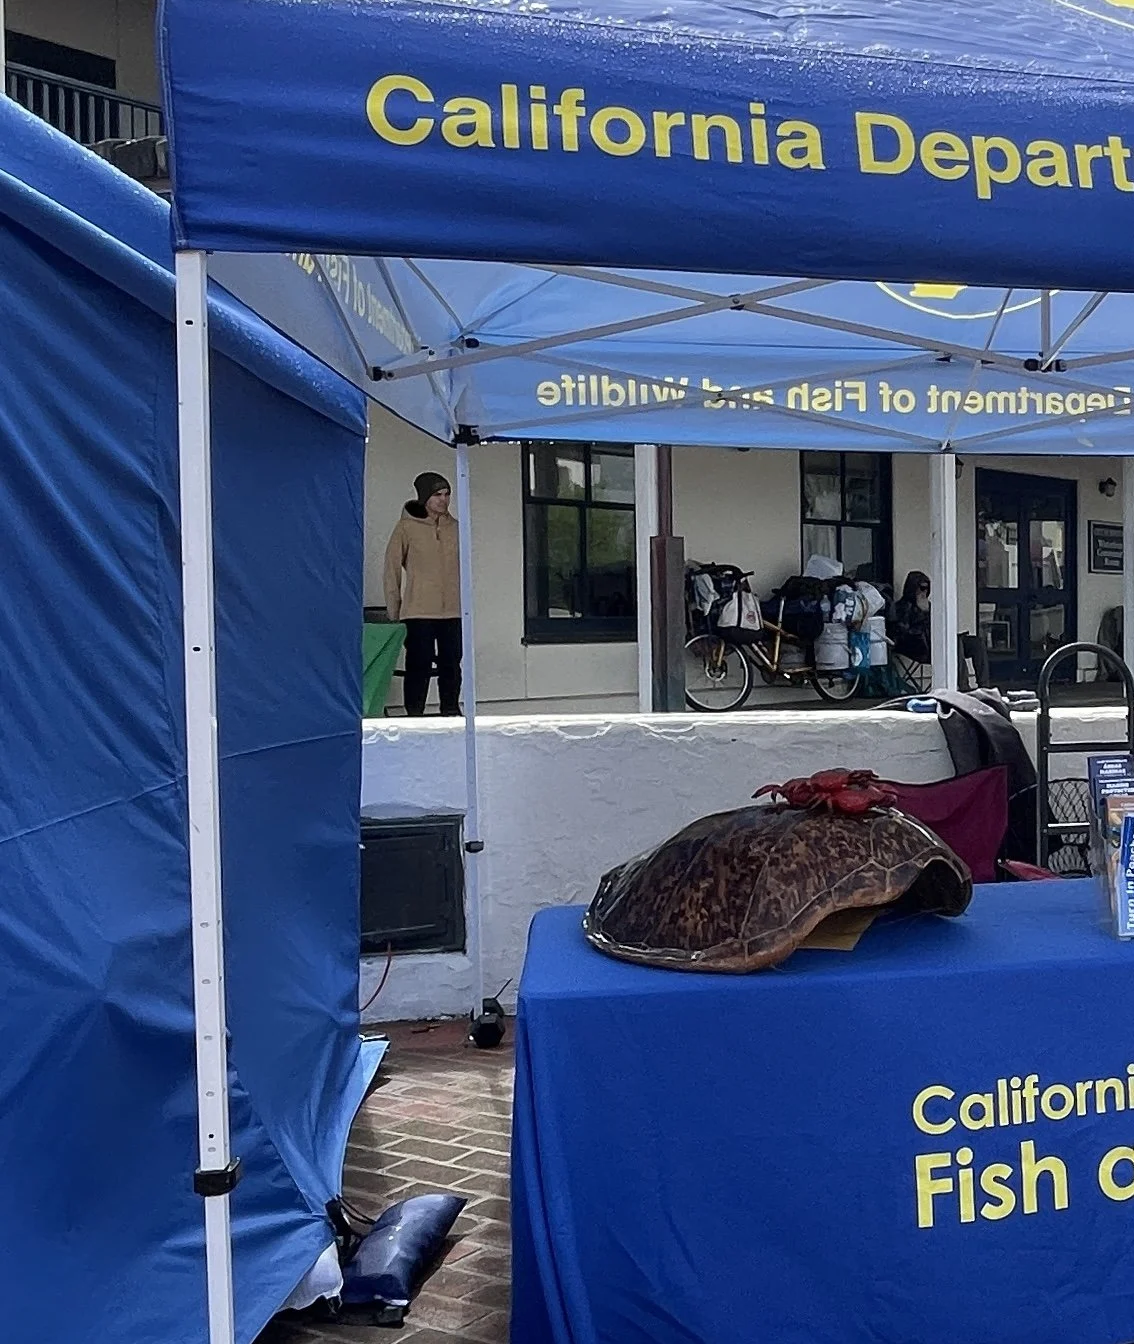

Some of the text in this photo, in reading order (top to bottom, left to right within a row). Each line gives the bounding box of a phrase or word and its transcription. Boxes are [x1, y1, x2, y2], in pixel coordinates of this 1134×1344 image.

[365, 73, 825, 170] California
[1126, 881, 1134, 894] In
[915, 1141, 1069, 1229] Fish
